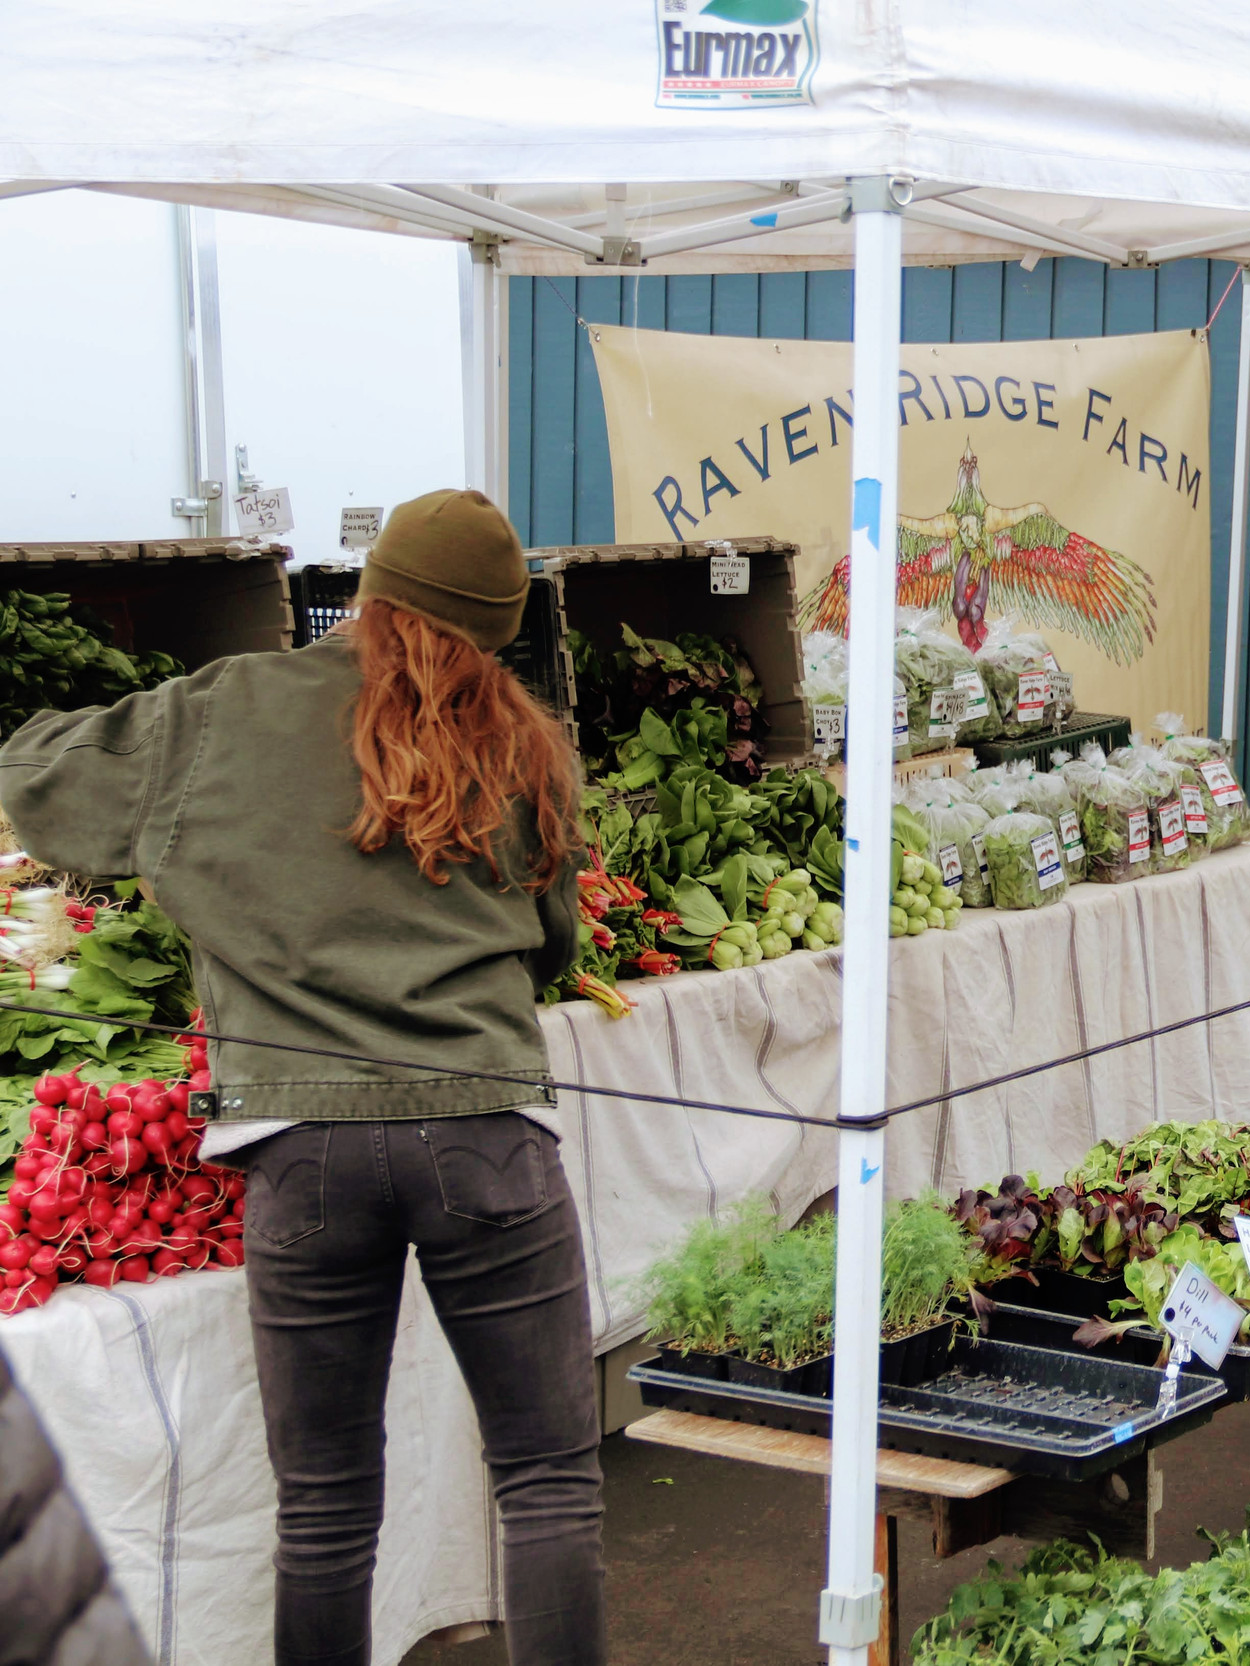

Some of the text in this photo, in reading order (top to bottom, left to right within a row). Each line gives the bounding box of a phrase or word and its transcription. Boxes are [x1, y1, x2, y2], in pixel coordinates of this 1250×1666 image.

[662, 21, 802, 78] Eurmax
[899, 370, 1059, 429] RIDGE
[1083, 387, 1202, 510] FARM
[235, 494, 281, 515] Tatsoi
[258, 512, 277, 528] $3
[722, 577, 739, 589] $2
[1186, 1277, 1209, 1304] Dill
[1178, 1300, 1192, 1319] $4
